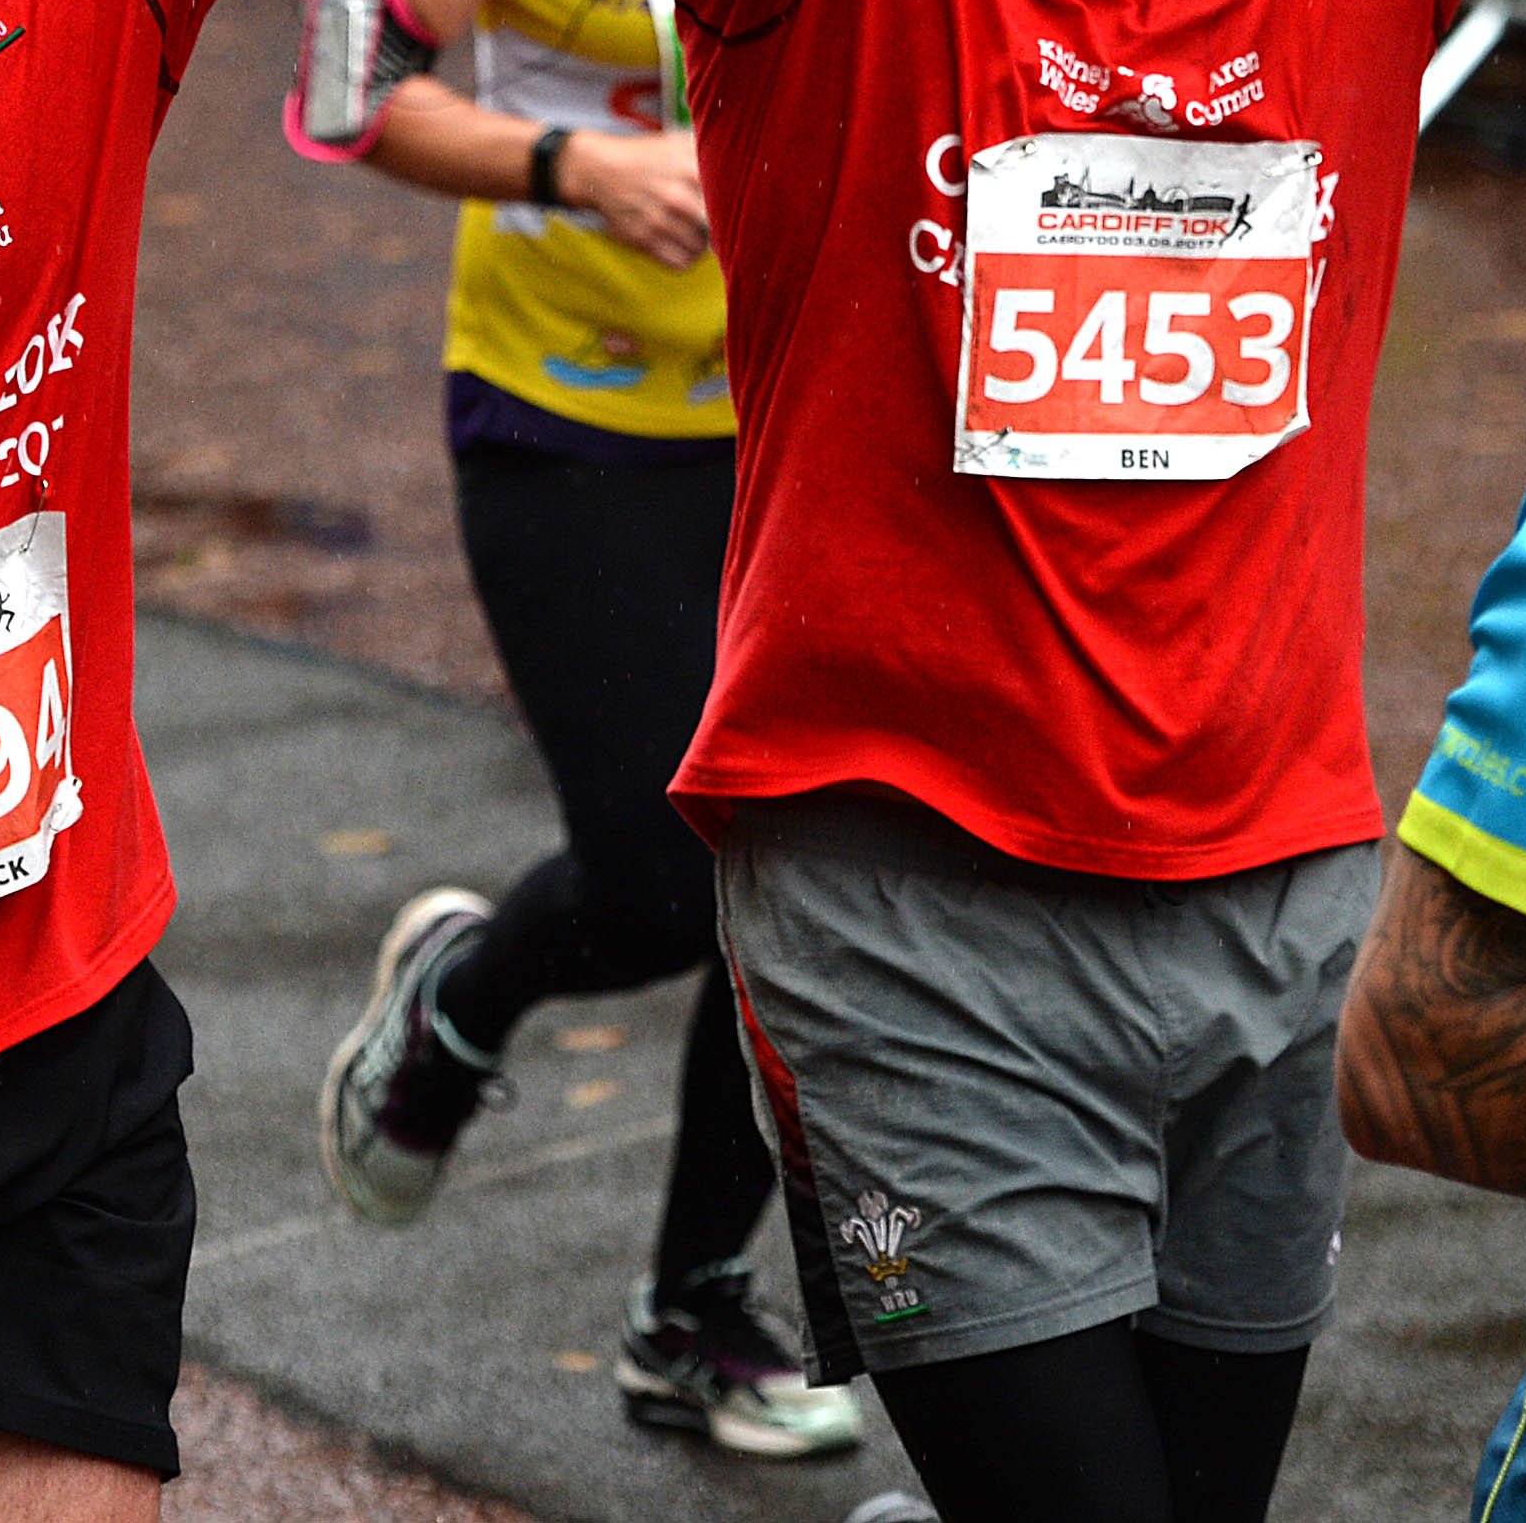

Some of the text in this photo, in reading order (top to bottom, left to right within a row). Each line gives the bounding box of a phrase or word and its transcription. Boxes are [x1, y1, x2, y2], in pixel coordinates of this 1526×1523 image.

[1038, 38, 1259, 94] Kidney Aren
[1185, 79, 1265, 126] Cymru
[1037, 213, 1231, 237] CARDIFF 10K
[983, 288, 1295, 406] 5453
[1121, 448, 1170, 469] BEN
